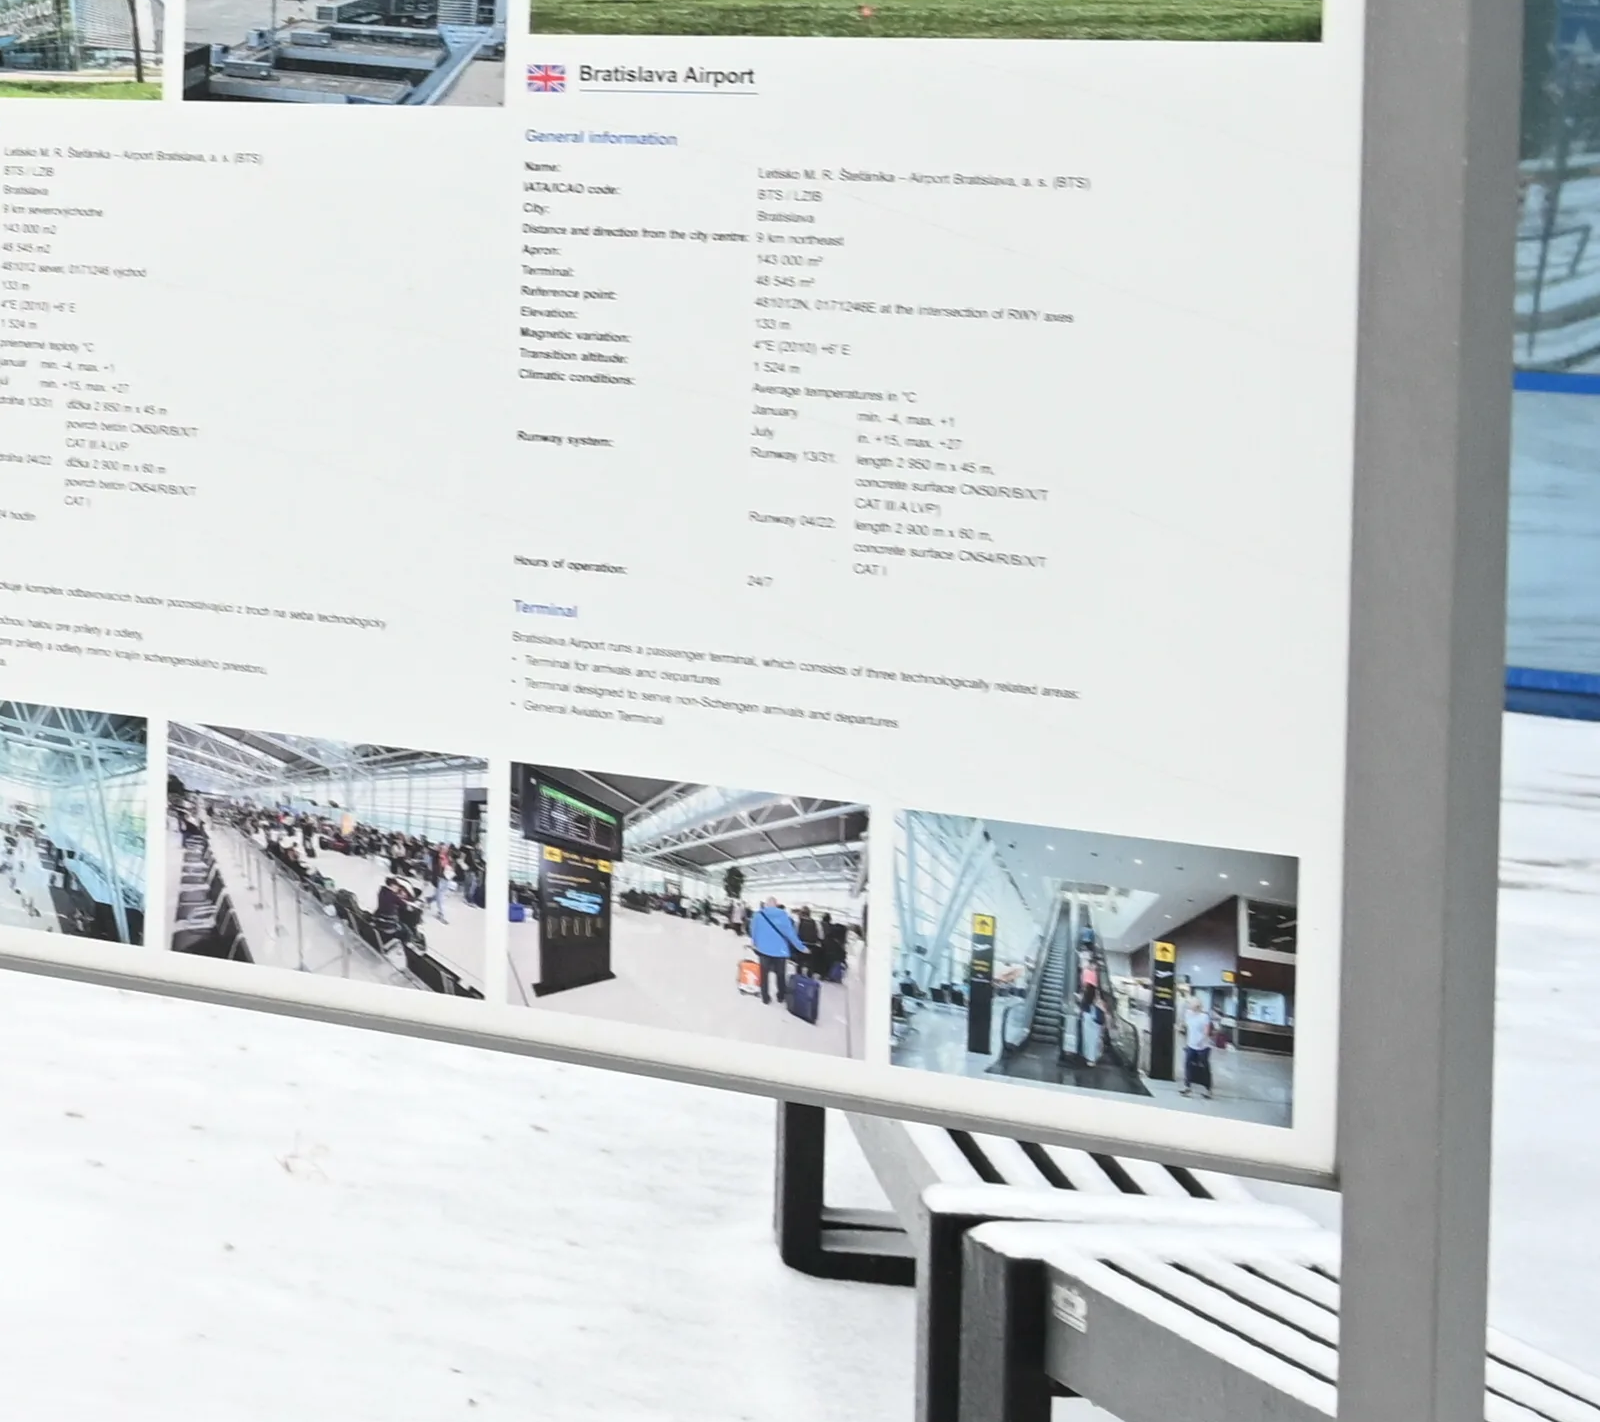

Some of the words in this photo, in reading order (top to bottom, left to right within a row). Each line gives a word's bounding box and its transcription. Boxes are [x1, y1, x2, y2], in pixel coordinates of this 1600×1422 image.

[579, 64, 678, 86] Bratislava
[682, 64, 756, 88] Airport
[525, 129, 584, 143] General
[588, 131, 677, 145] information
[524, 162, 559, 172] Name:
[523, 202, 549, 215] City:
[757, 210, 815, 223] Bratislava
[522, 264, 574, 277] Terminal:
[513, 599, 578, 618] Terminal
